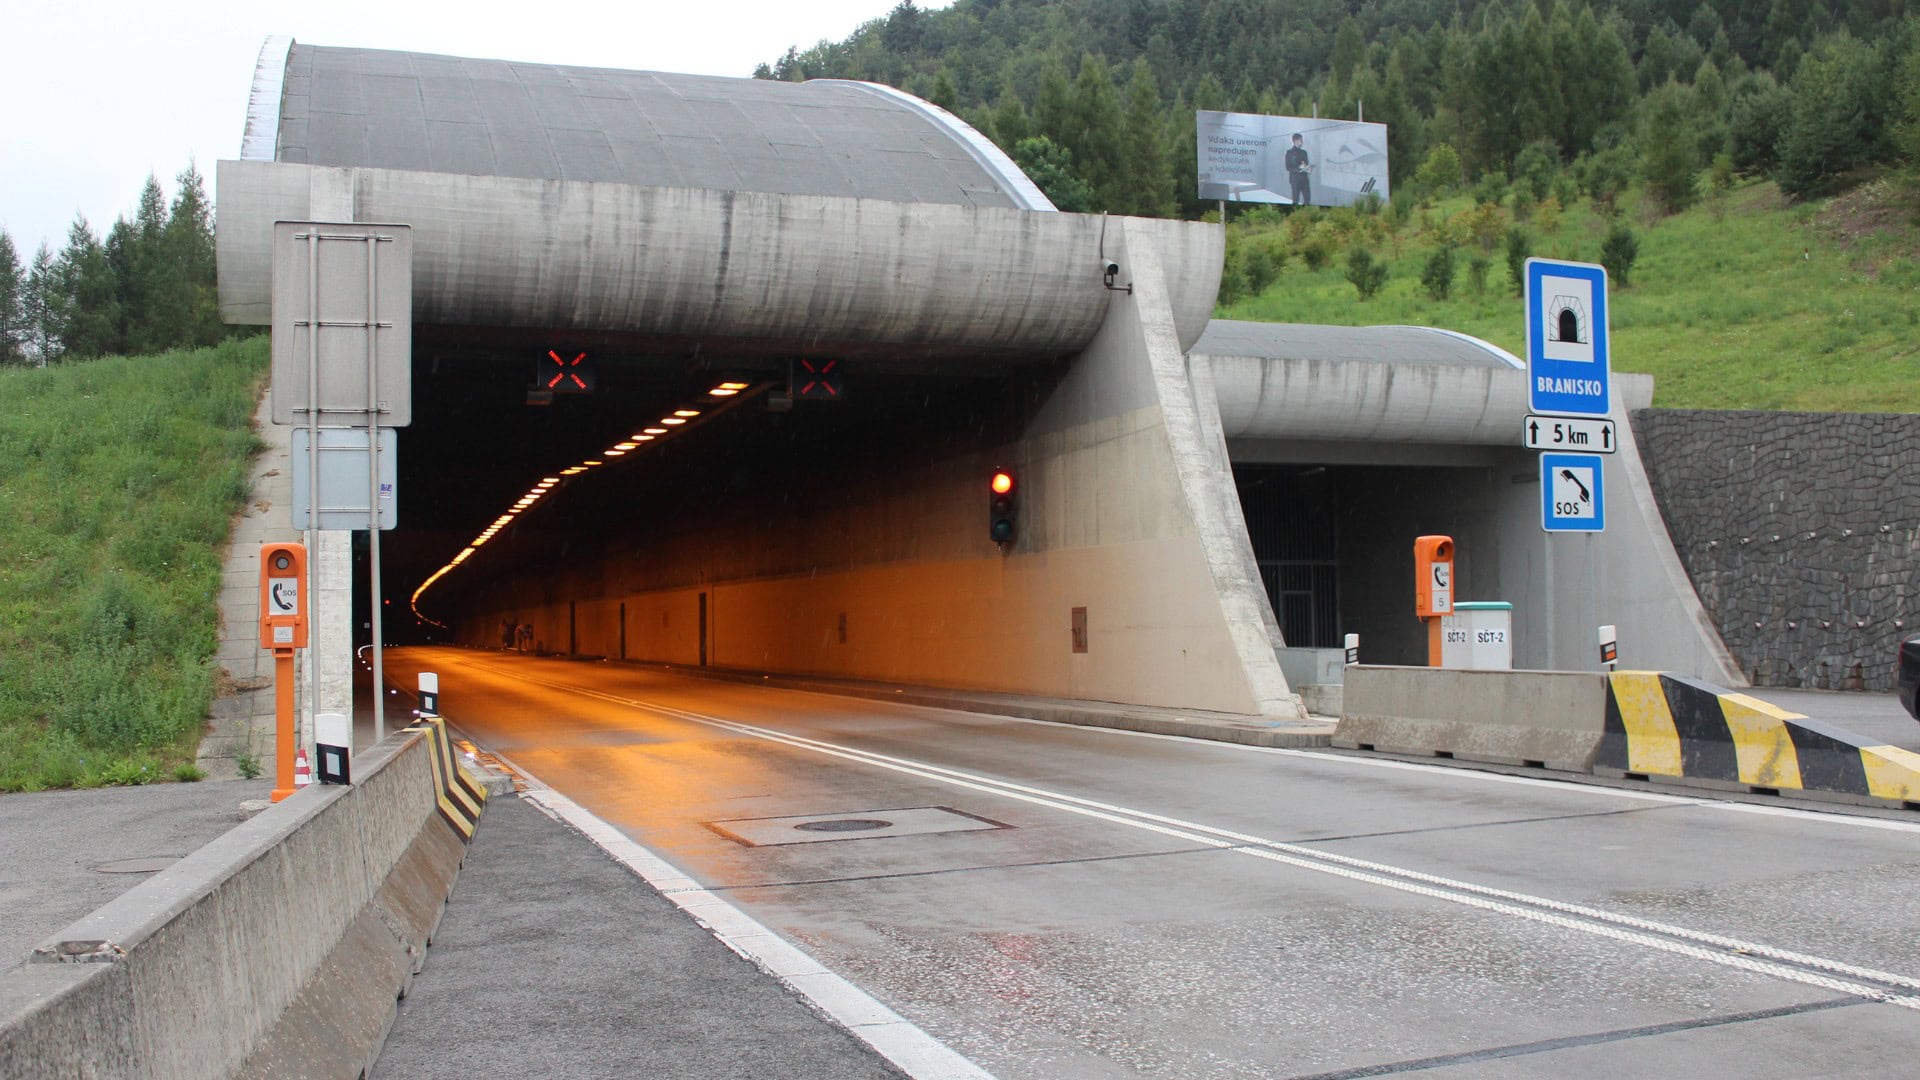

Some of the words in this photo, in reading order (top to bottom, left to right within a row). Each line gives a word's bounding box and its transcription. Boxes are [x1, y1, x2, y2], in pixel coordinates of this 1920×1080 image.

[1537, 376, 1602, 396] BRANISKO
[1553, 423, 1563, 443] 5
[1568, 425, 1588, 445] km
[1556, 501, 1580, 515] SOS
